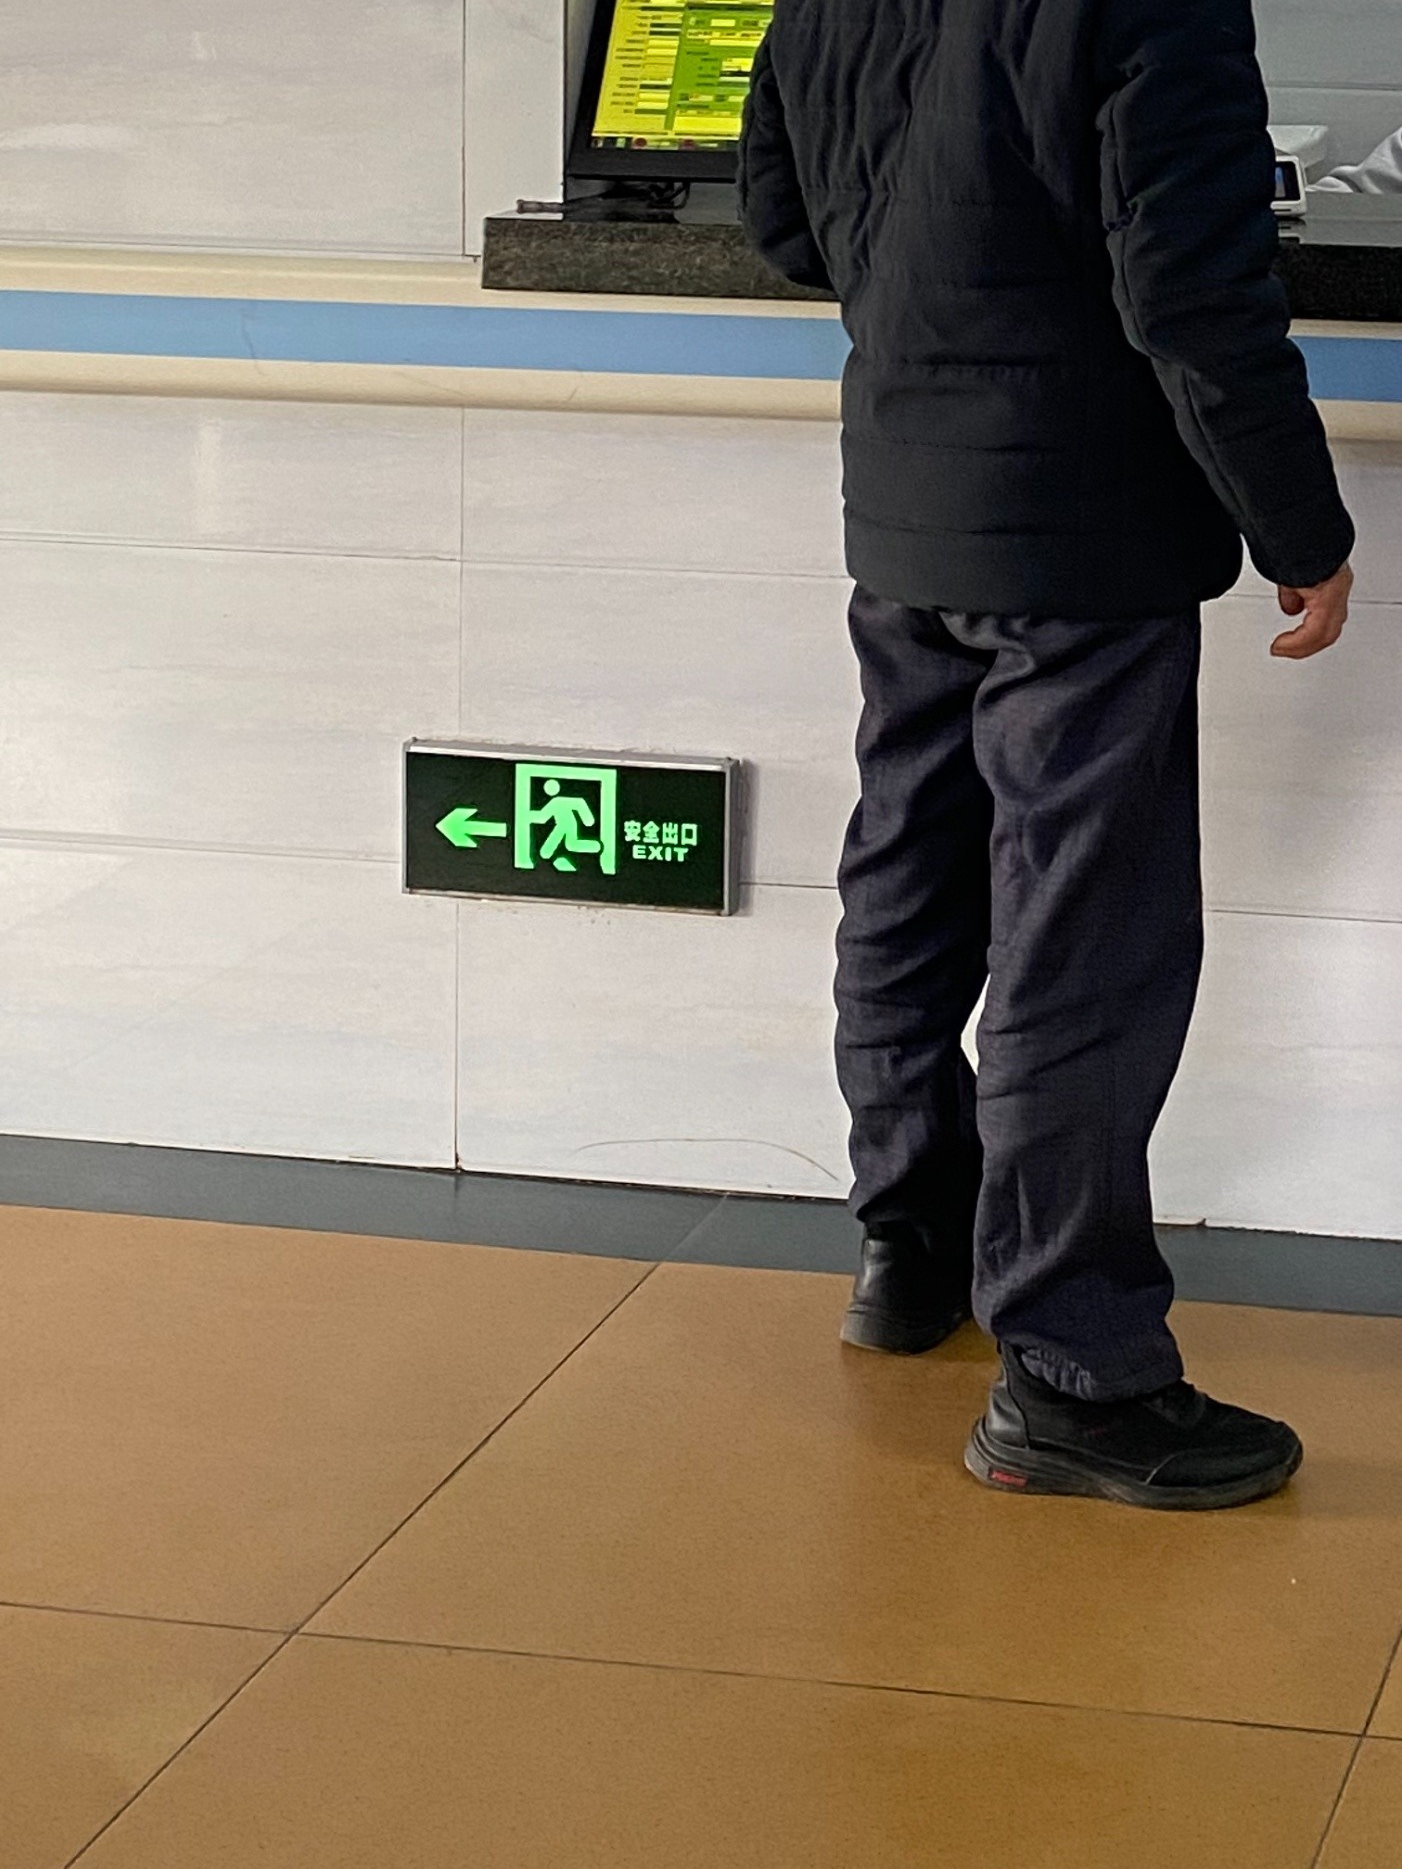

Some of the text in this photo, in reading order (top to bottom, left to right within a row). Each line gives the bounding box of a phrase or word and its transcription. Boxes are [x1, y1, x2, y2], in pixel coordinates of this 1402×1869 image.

[623, 820, 698, 846] 安全出口
[632, 844, 689, 862] EXIT
